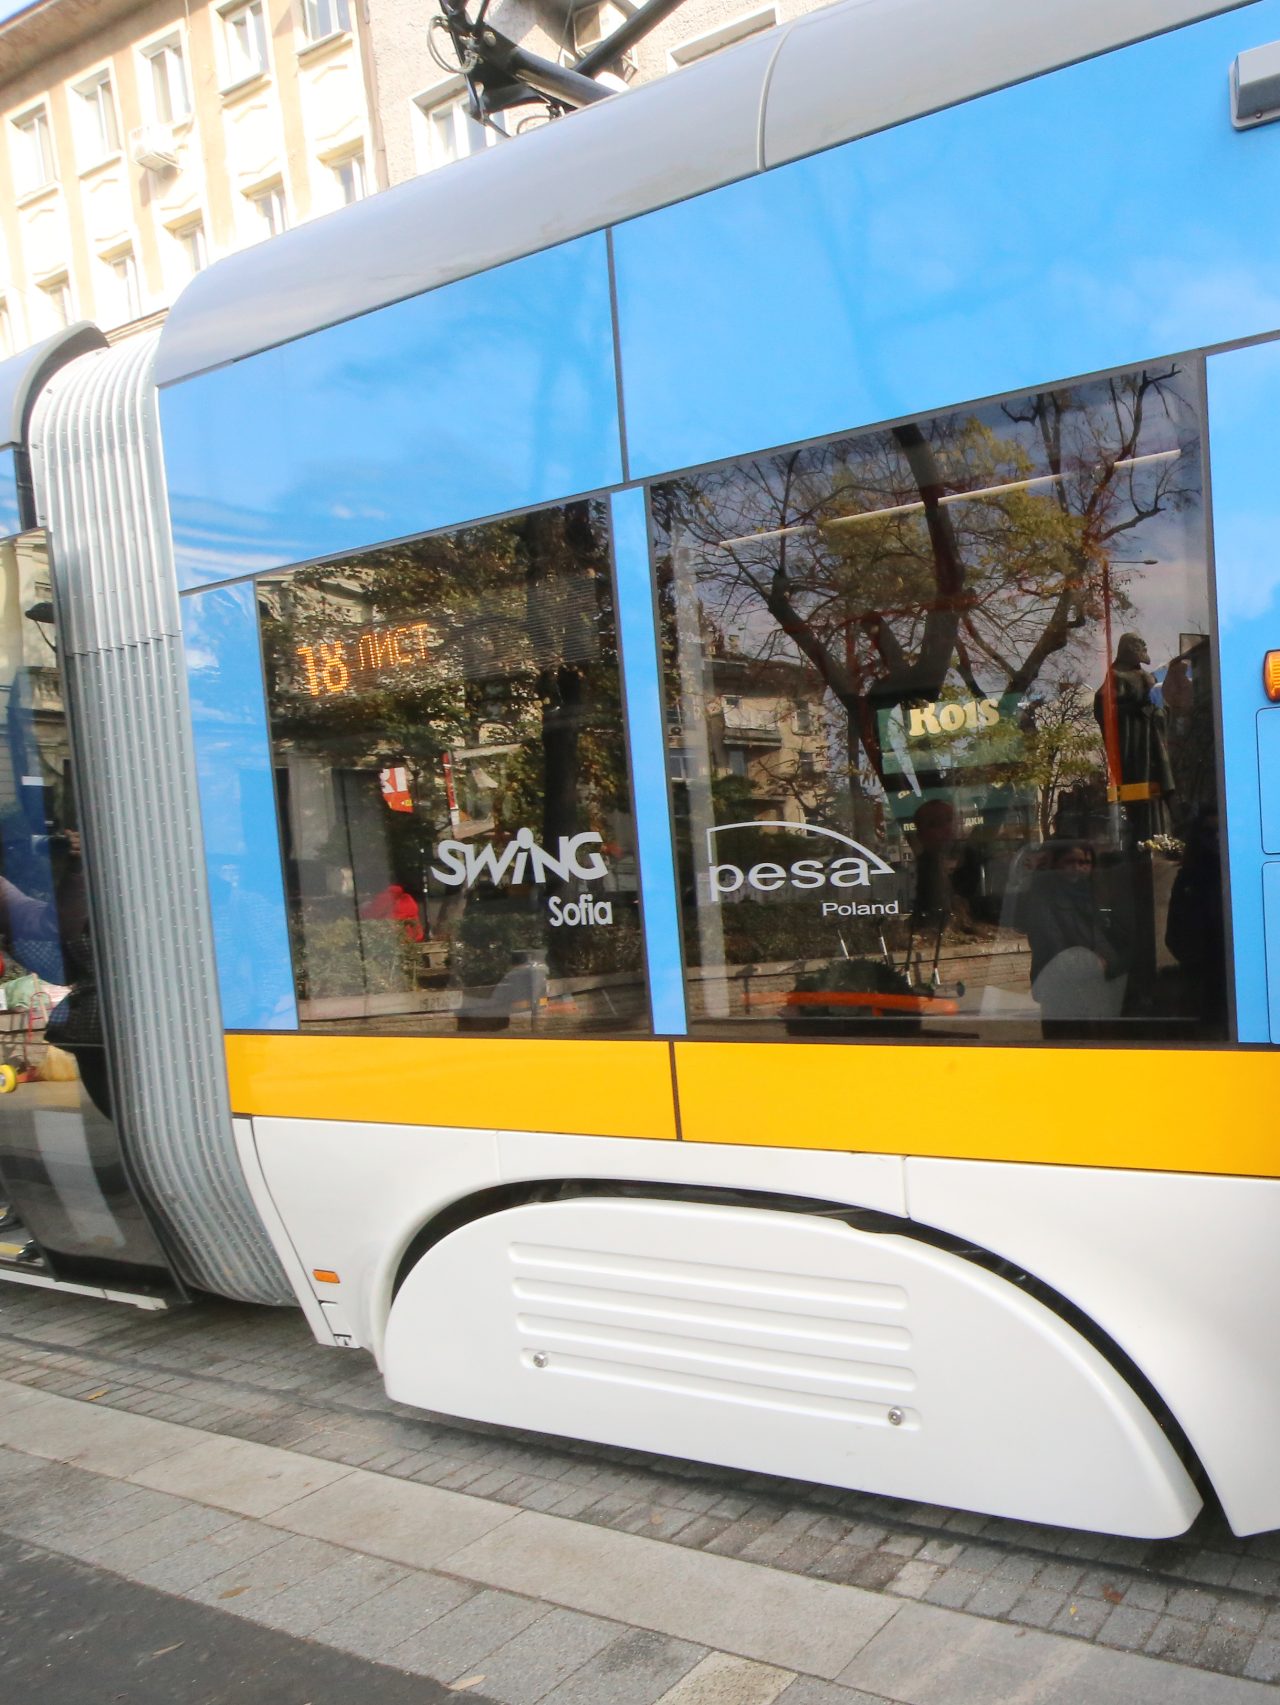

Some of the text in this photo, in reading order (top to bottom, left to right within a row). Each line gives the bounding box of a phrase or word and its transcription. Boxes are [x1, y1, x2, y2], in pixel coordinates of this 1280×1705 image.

[709, 857, 871, 902] pesa
[548, 893, 613, 927] Sofia
[822, 900, 899, 916] Poland
